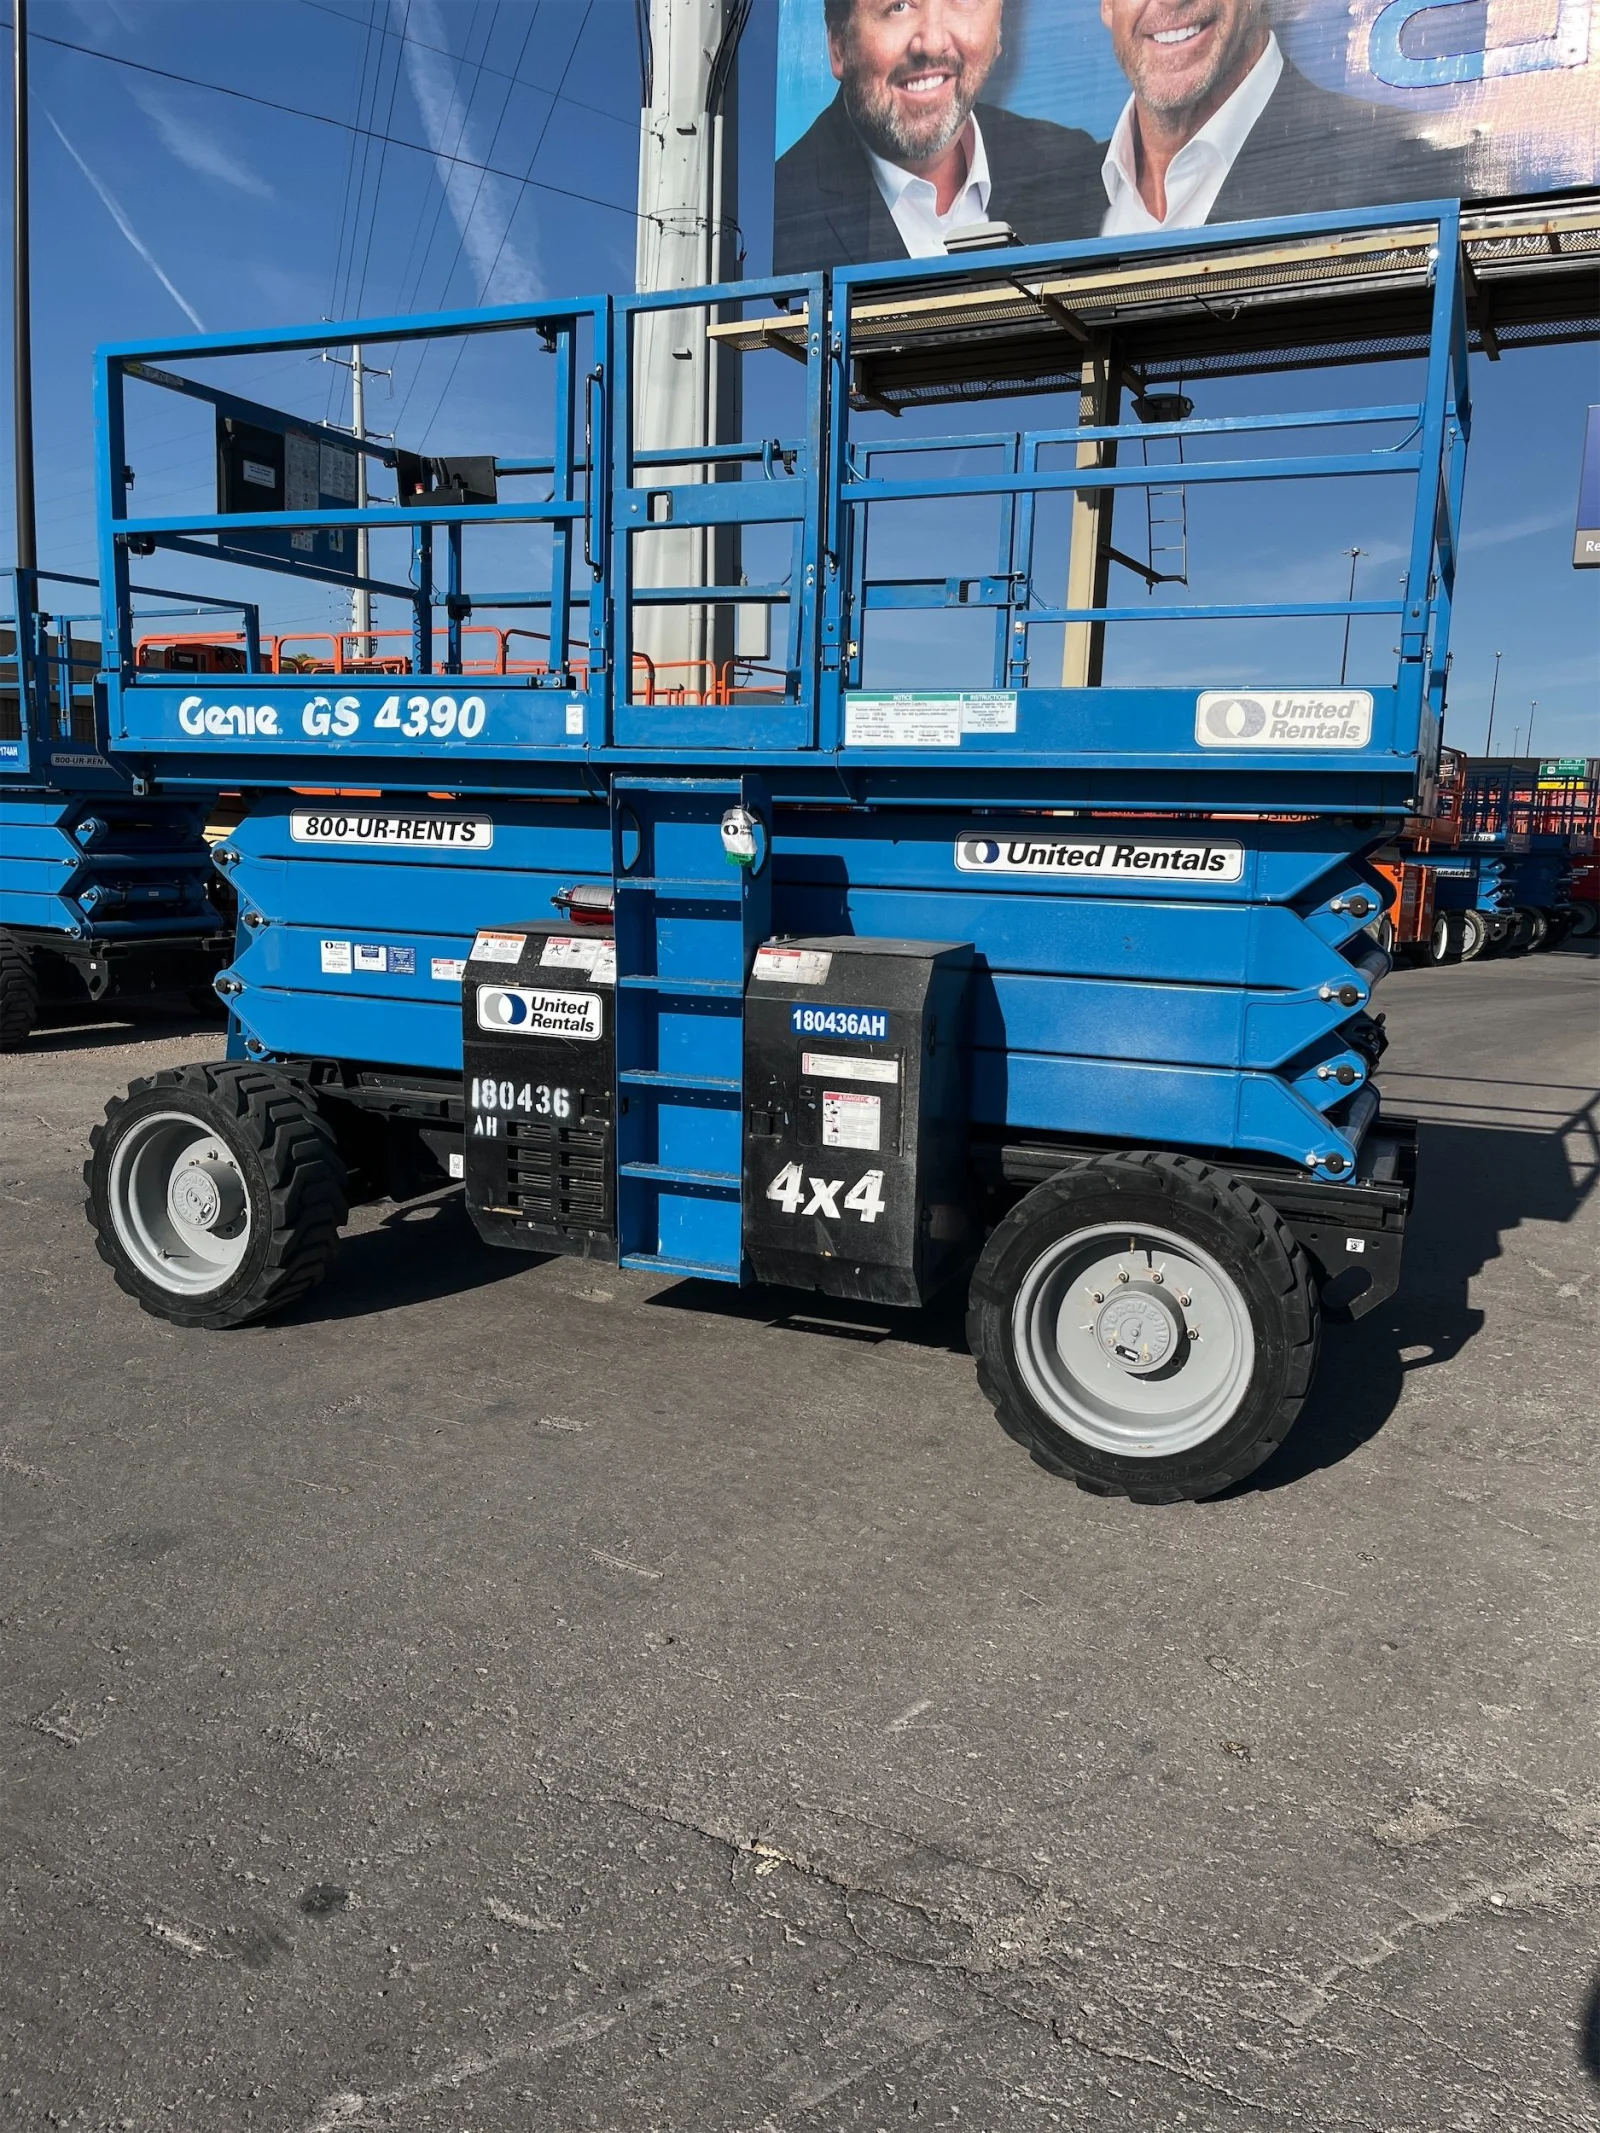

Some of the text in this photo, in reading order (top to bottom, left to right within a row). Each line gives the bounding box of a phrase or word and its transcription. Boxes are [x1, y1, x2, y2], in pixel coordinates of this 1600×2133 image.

[179, 696, 486, 737] Genie GS 4390
[1270, 699, 1354, 720] United
[1269, 720, 1361, 741] Rentals
[306, 817, 476, 842] 800-UR-RENTS
[1007, 841, 1227, 873] United Rentals
[531, 996, 589, 1015] United
[531, 1013, 594, 1032] Rentals
[793, 1009, 885, 1037] 180436AH
[472, 1077, 570, 1118] 180436
[474, 1115, 497, 1137] AH
[766, 1161, 886, 1223] 4x4
